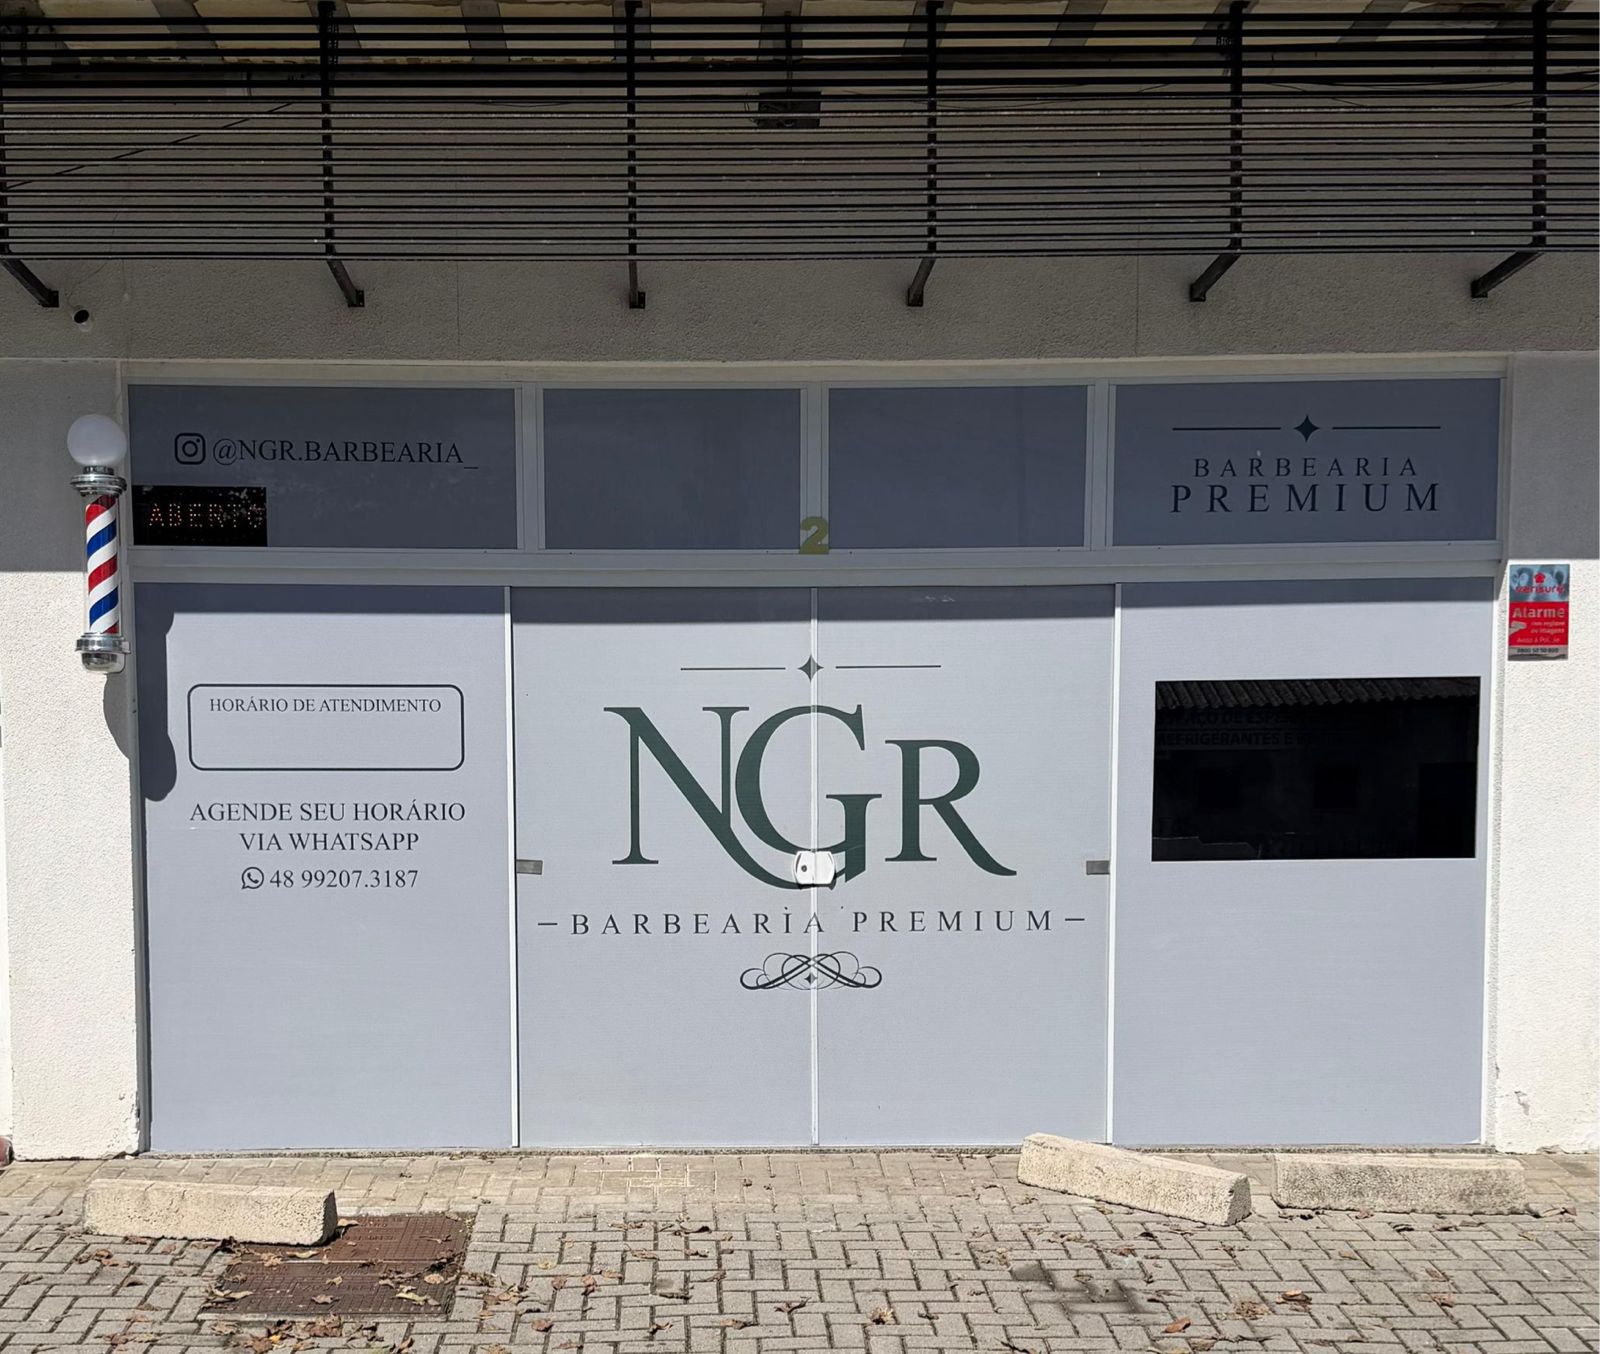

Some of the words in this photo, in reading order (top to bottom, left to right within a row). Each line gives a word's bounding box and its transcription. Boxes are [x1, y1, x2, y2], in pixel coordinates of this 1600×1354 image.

[213, 438, 479, 470] @NGR.BARBEARIA_
[1194, 457, 1418, 478] BARBEARIA
[1170, 482, 1440, 513] PREMIUM
[799, 516, 830, 554] 2
[1512, 606, 1566, 618] Alarme
[209, 696, 289, 713] HORÁRIO
[293, 698, 316, 712] DE
[319, 698, 442, 713] ATENDIMENTO
[603, 703, 1018, 890] NGR
[189, 802, 293, 822] AGENDE
[299, 802, 346, 821] SEU
[353, 799, 466, 821] HORÁRIO
[239, 832, 283, 851] VIA
[288, 832, 420, 851] WHATSAPP
[269, 869, 294, 888] 48
[301, 869, 419, 888] 99207.3187
[571, 912, 825, 935] BARBEARIA
[852, 910, 1052, 932] PREMIUM
